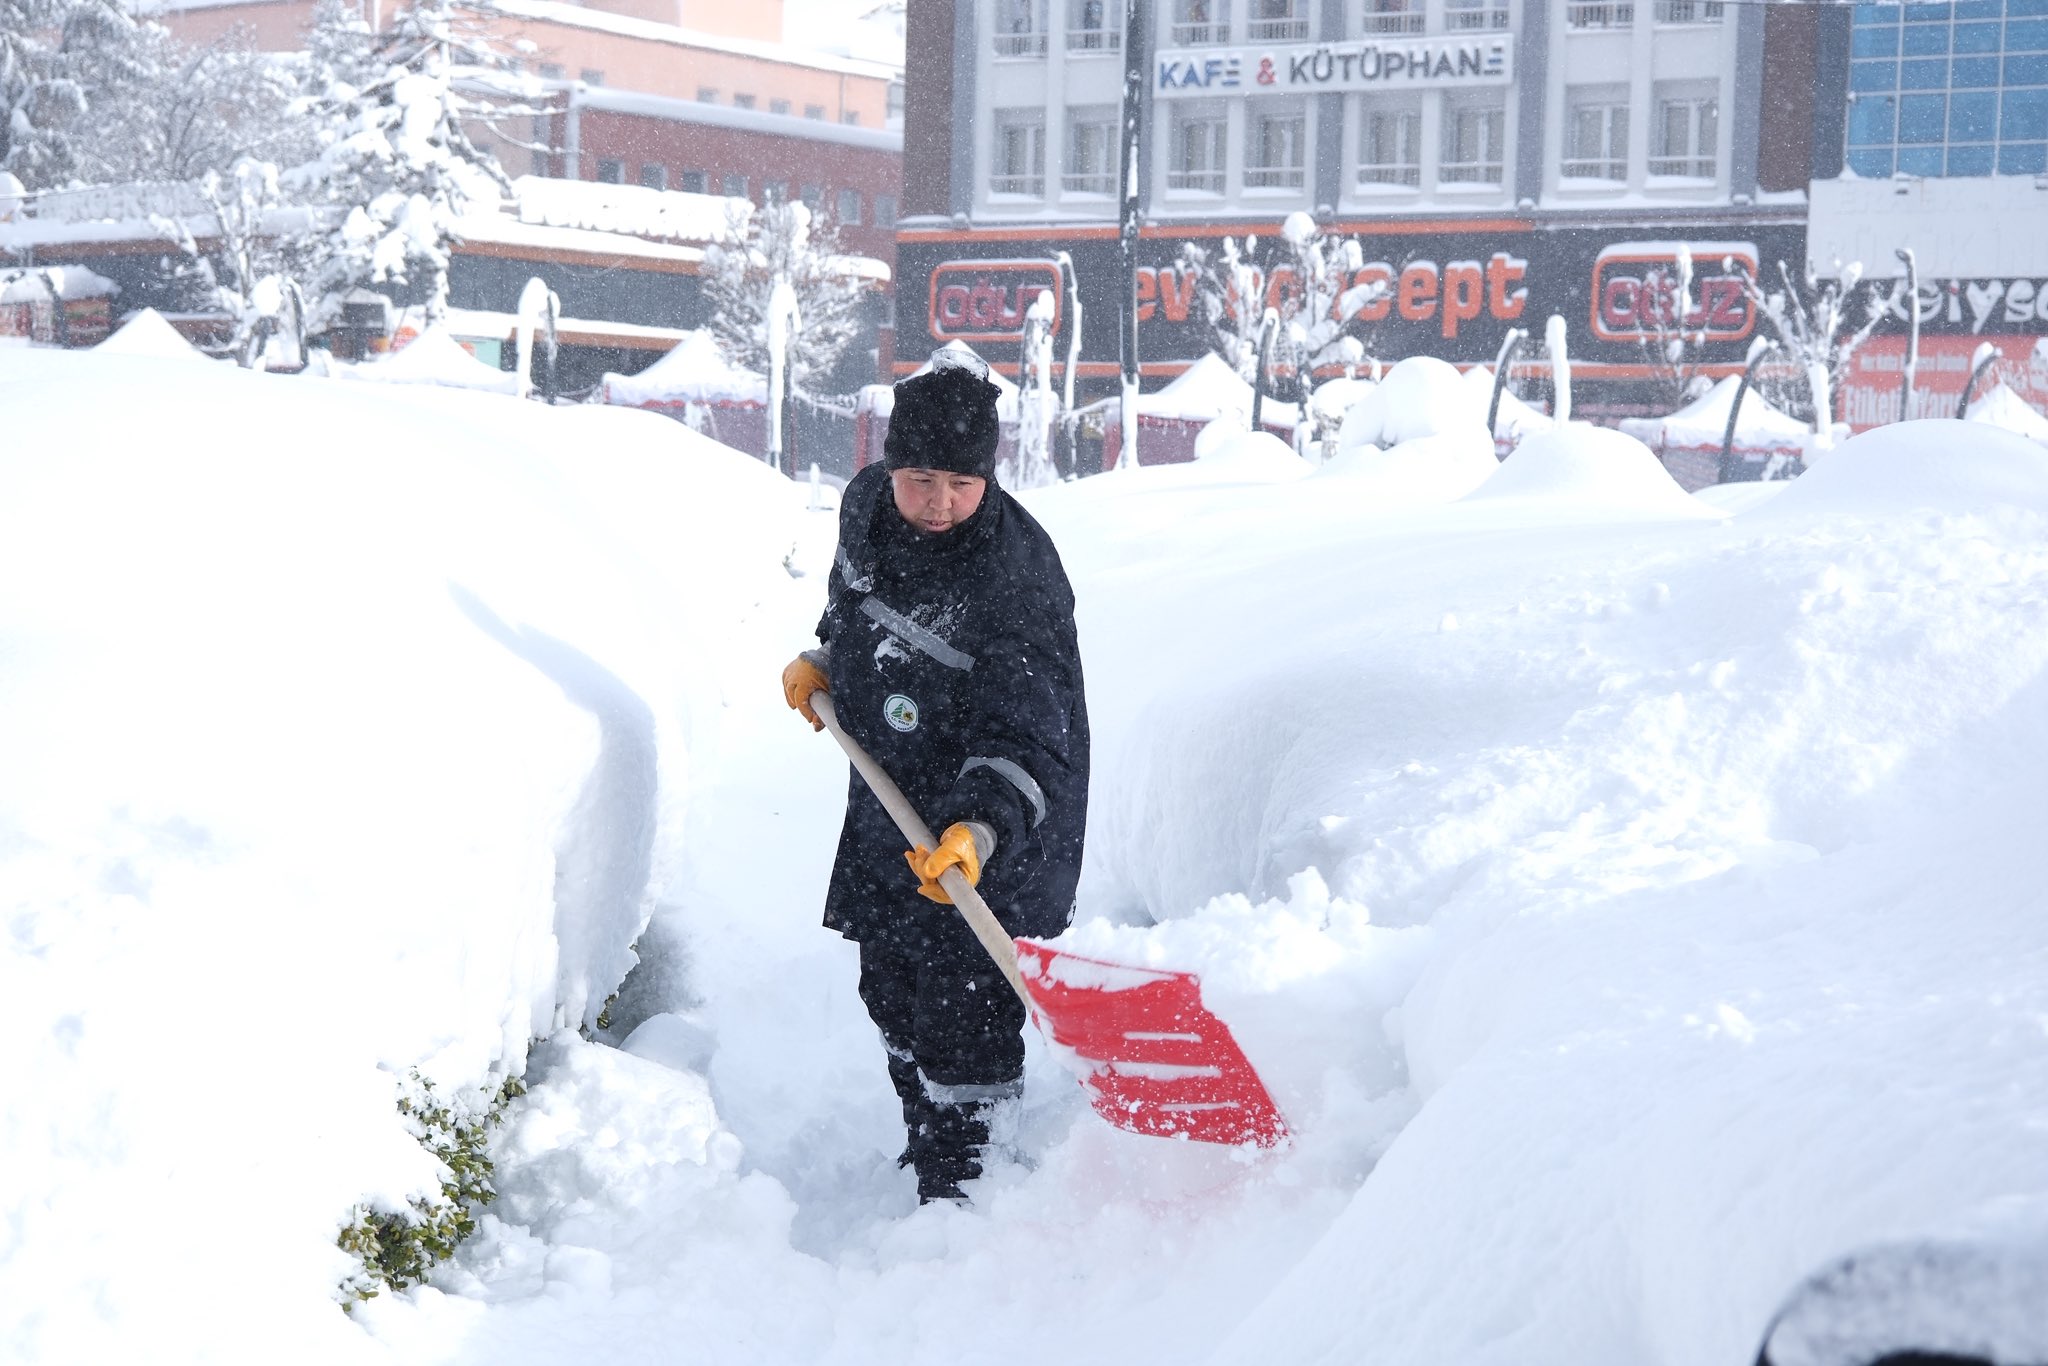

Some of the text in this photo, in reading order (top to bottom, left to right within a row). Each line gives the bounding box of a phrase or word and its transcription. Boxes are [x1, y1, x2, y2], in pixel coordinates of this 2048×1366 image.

[1159, 46, 1504, 88] KAFE & KÜTÜPHANE
